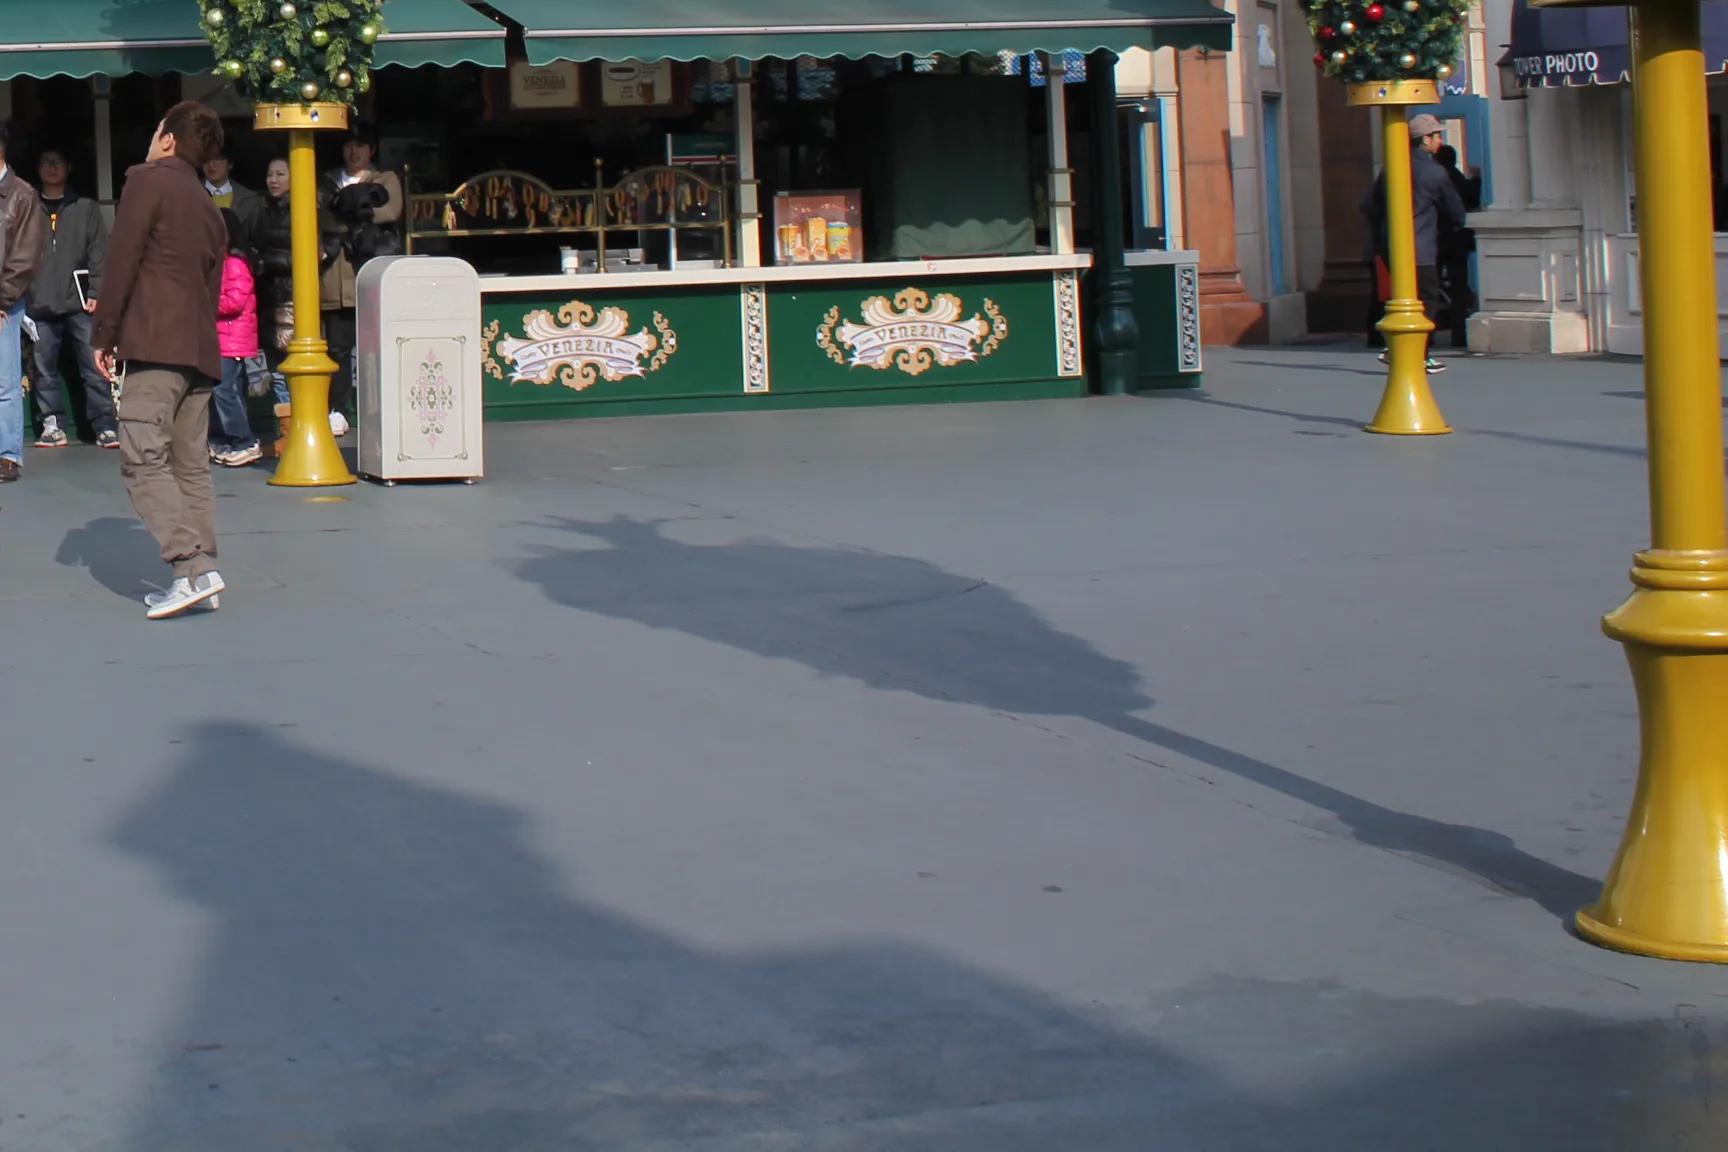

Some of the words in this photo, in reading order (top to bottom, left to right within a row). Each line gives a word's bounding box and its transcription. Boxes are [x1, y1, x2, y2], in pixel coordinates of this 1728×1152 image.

[1514, 56, 1543, 75] TOWER
[1545, 51, 1599, 74] PHOTO
[874, 325, 947, 341] VENEZIA
[537, 339, 614, 356] VENEZIA
